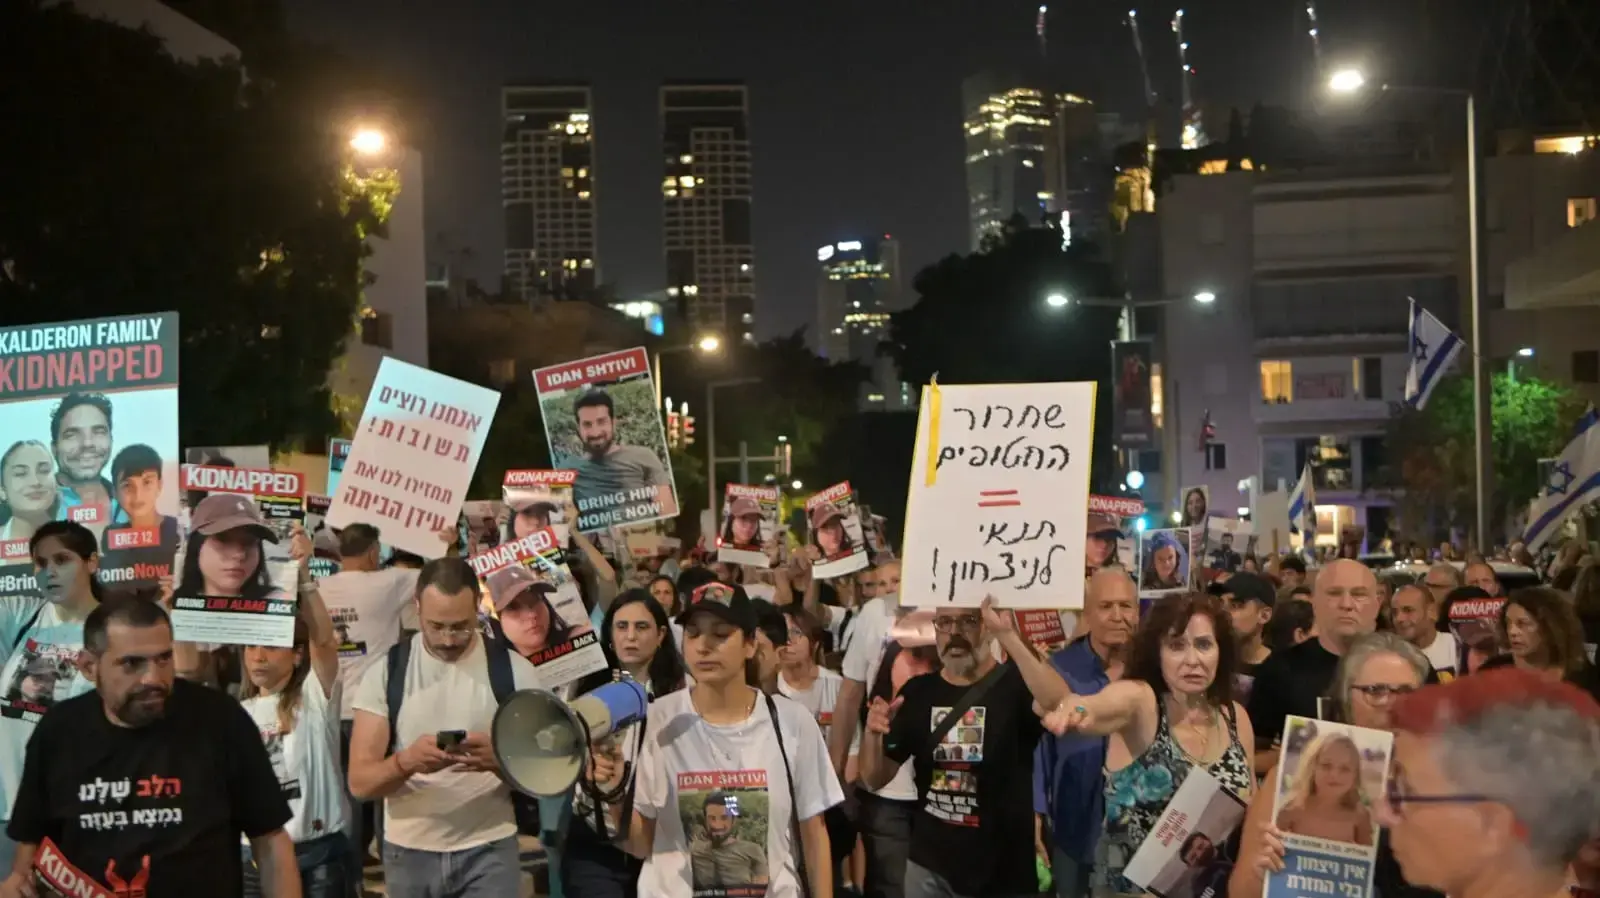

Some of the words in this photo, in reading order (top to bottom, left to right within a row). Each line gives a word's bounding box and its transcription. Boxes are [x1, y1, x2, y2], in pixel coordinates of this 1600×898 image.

[0, 324, 92, 354] KALDERON
[96, 318, 163, 346] FAMILY
[0, 344, 164, 392] KIDNAPPED
[547, 369, 582, 387] IDAN
[586, 356, 636, 378] SHTIVI
[379, 385, 428, 415] רוצים
[430, 401, 483, 433] אנחנו
[953, 404, 1067, 431] שחרור
[936, 435, 1070, 471] החטופים
[186, 466, 300, 494] KIDNAPPED
[353, 460, 380, 481] את
[380, 467, 403, 488] לנו
[506, 471, 576, 484] KIDNAPPED
[342, 485, 404, 521] הביתה
[578, 492, 626, 511] BRING
[629, 485, 659, 502] HIM
[73, 508, 97, 521] OFER
[404, 505, 447, 533] עידן
[578, 510, 622, 529] HOME
[626, 501, 665, 521] NOW!
[115, 532, 138, 546] EREZ
[978, 519, 1057, 547] תנאי
[465, 529, 552, 576] IDNAPPED
[267, 602, 293, 613] BACK
[679, 774, 713, 787] IDAN
[718, 772, 766, 785] SHTIVI
[1296, 855, 1340, 876] ניצחון
[1343, 863, 1367, 880] אין
